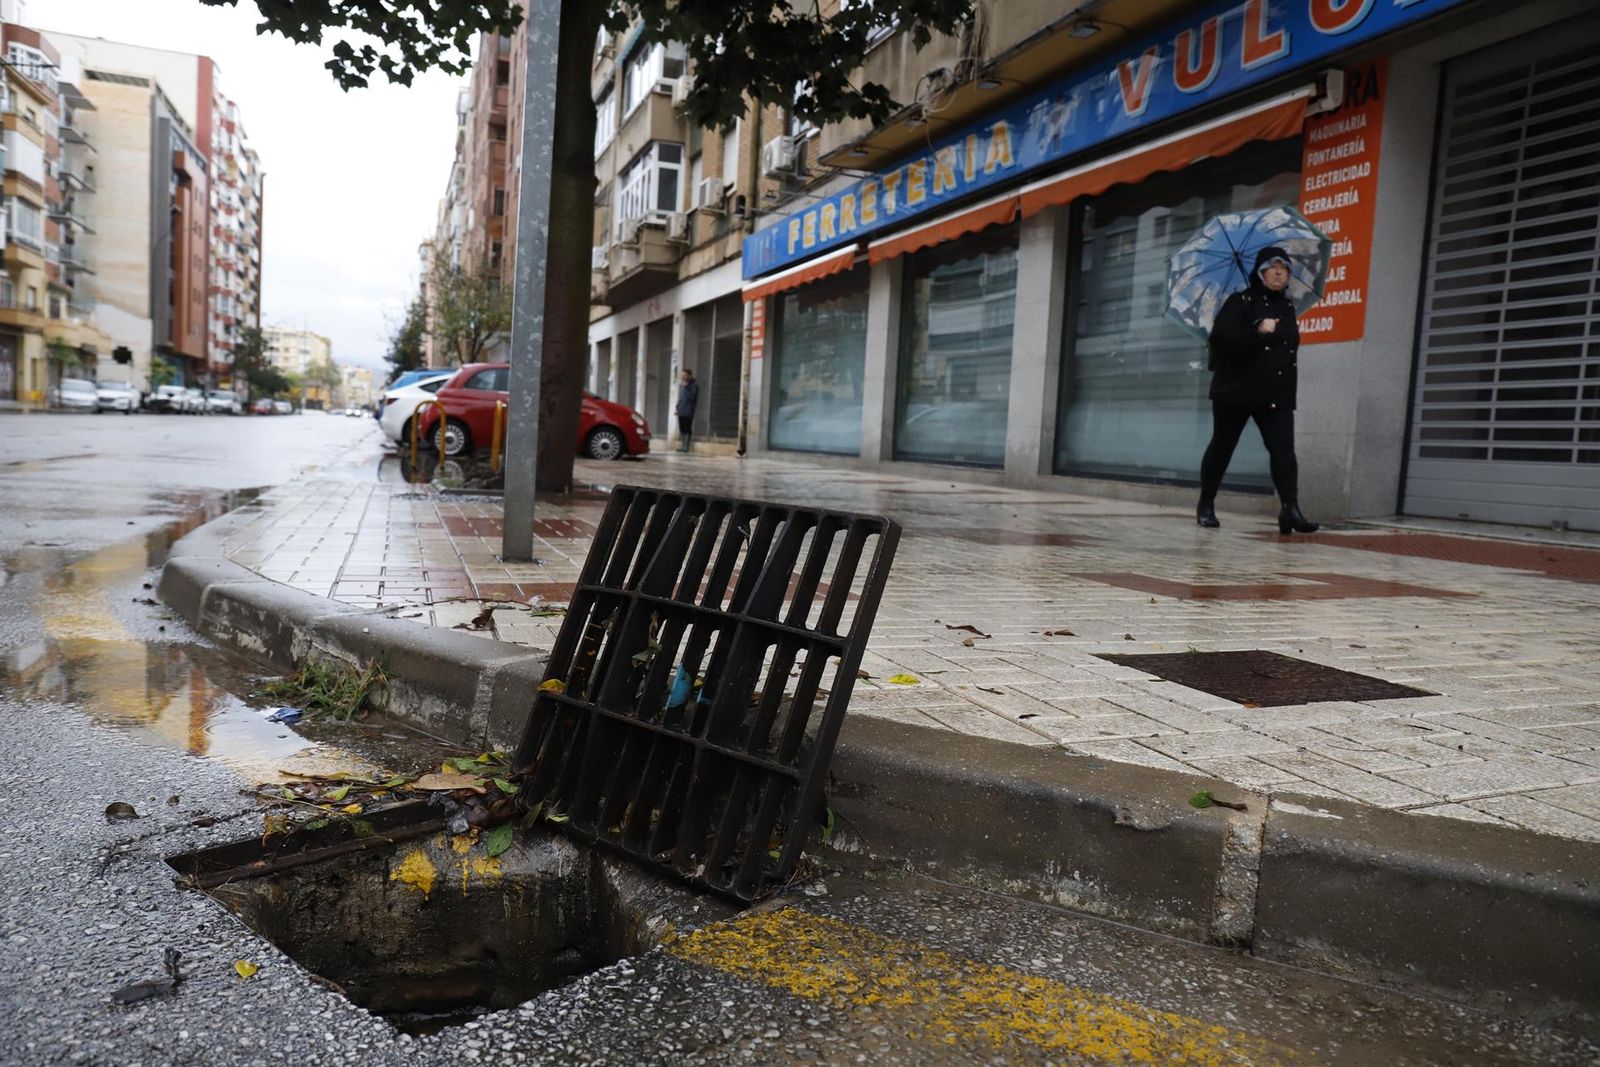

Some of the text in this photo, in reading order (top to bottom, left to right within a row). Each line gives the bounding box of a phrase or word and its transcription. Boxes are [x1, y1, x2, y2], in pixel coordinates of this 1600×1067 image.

[787, 0, 1427, 255] FERRETERIA VUL
[1309, 113, 1367, 143] MAQUINARIA
[1306, 138, 1365, 168] FONTANERÍA
[1305, 162, 1370, 192] ELECTRICIDAD
[1303, 186, 1359, 215] CERRAJERÍA
[1314, 218, 1340, 234] TURA
[1320, 289, 1362, 307] LABORAL
[1296, 316, 1334, 333] ALZADO
